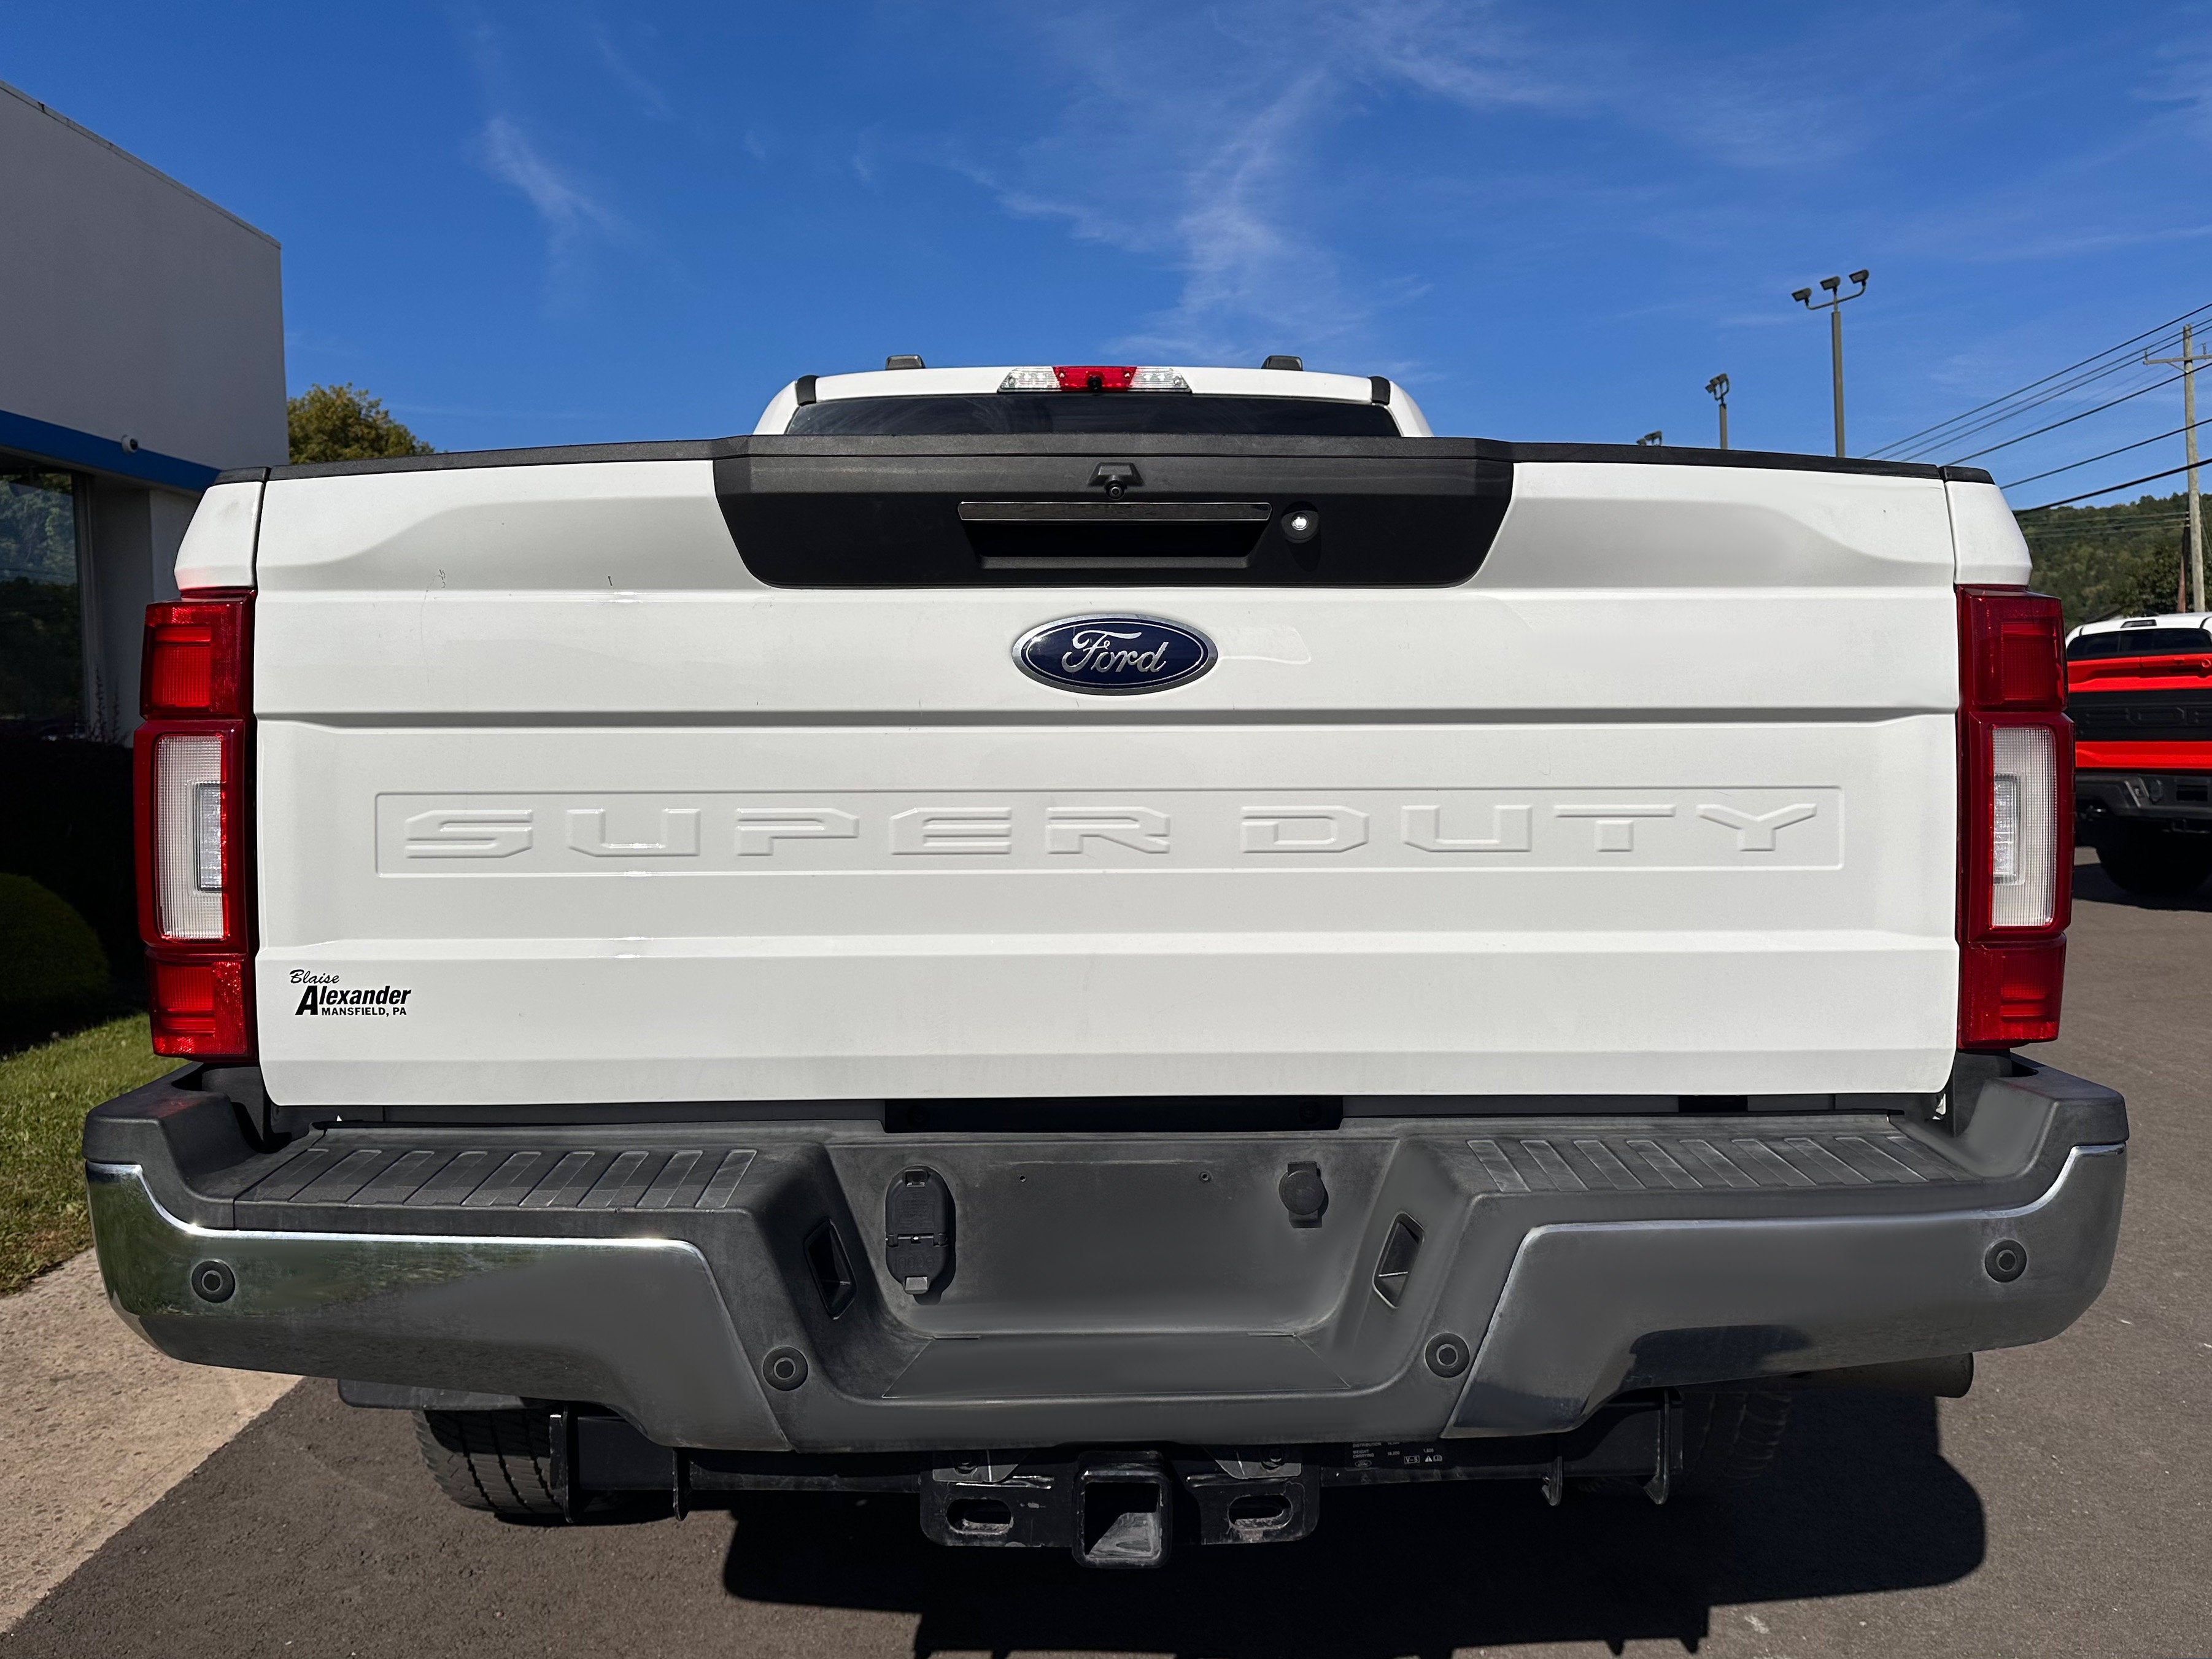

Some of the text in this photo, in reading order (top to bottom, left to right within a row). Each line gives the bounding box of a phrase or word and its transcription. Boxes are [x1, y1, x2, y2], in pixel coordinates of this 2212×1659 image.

[1061, 630, 1169, 673] Ford
[404, 803, 1818, 859] SUPER DUTY
[289, 969, 340, 984] Blaise
[295, 985, 412, 1016] Alexander
[322, 1007, 407, 1017] MANSFIELD, PA
